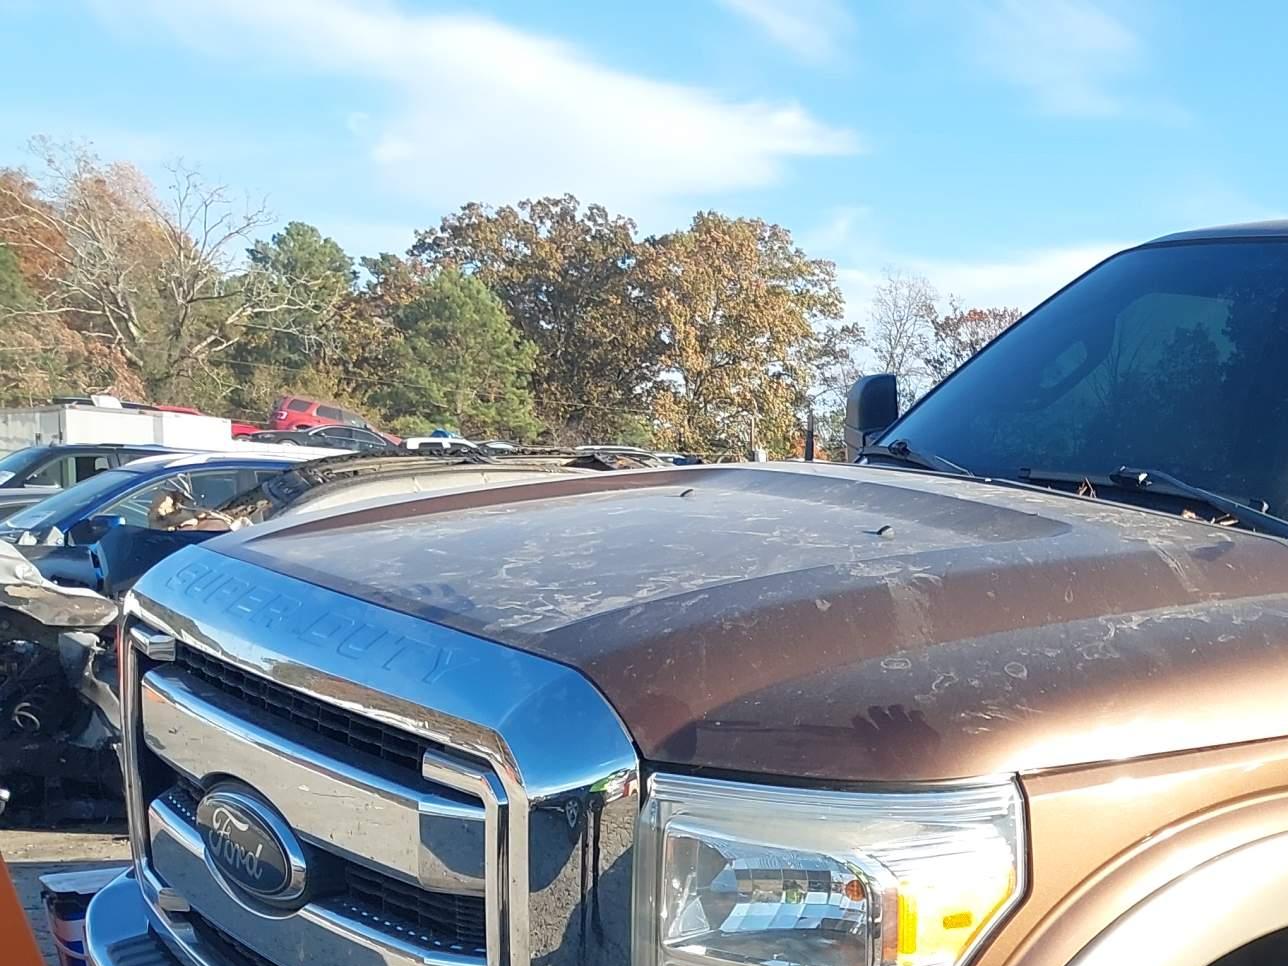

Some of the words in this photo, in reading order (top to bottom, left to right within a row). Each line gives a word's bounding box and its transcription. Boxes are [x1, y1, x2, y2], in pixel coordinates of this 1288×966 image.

[165, 560, 301, 629] SUPER
[299, 611, 482, 685] DUTY
[208, 806, 264, 881] Ford
